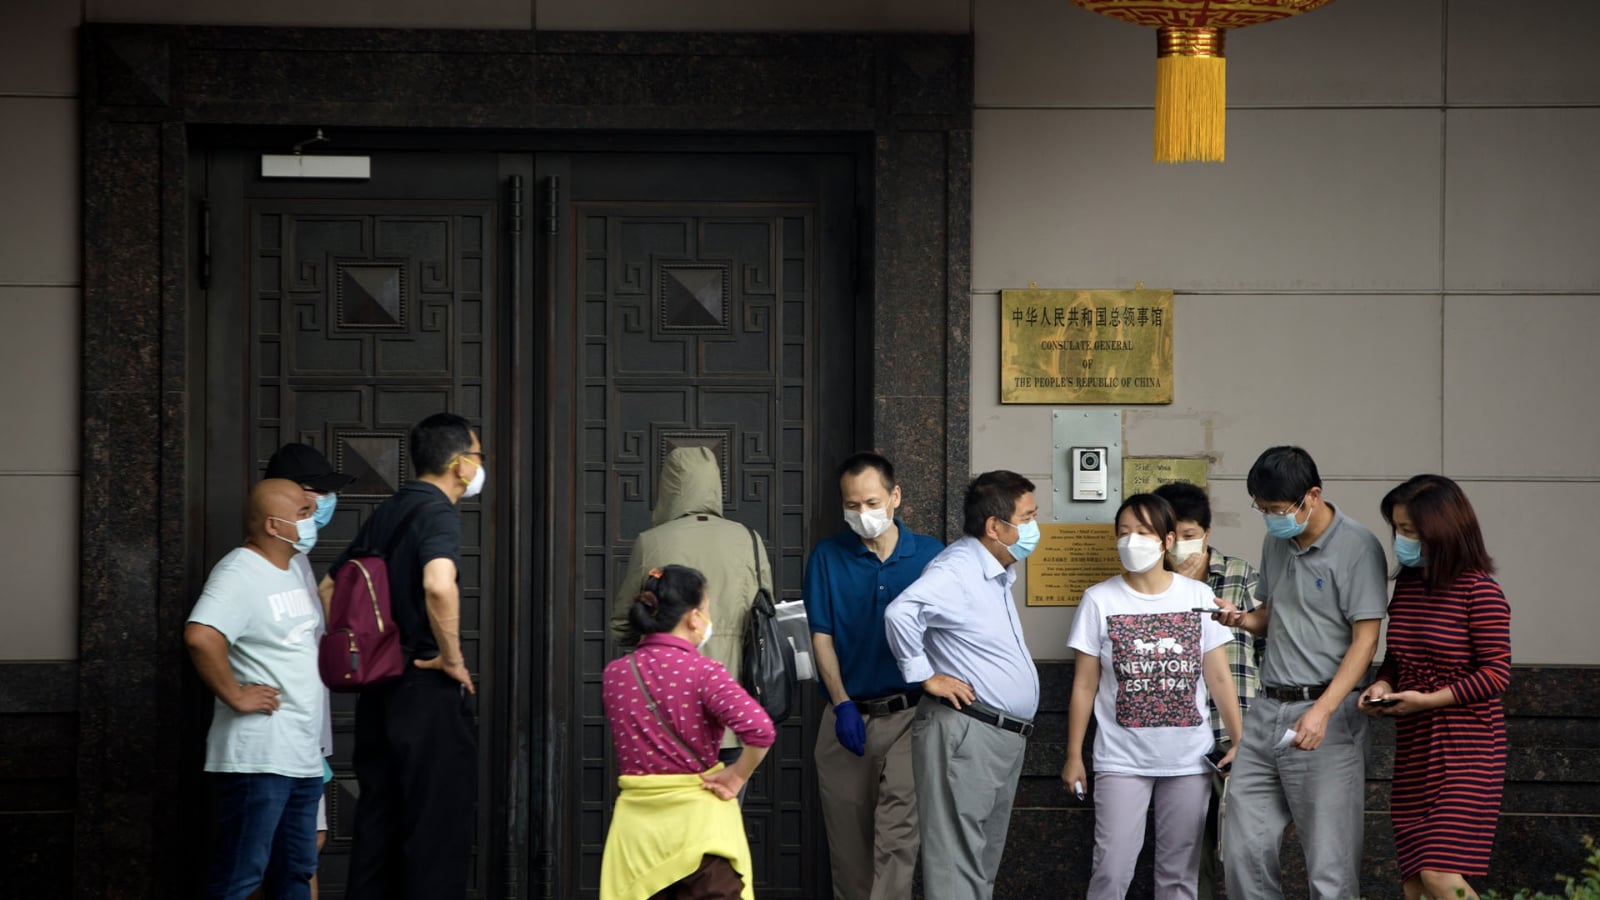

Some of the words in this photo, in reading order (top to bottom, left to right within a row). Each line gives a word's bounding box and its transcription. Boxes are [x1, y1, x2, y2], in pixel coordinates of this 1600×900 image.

[1012, 306, 1163, 327] 中华人民共和国总领事馆
[1041, 340, 1091, 351] CONSULATE
[1093, 340, 1134, 351] GENERAL
[1082, 359, 1094, 370] OF
[1014, 377, 1032, 388] THE
[1034, 377, 1074, 388] PEOPLE'S
[1076, 377, 1119, 388] REPUBLIC
[1121, 377, 1132, 388] OF
[1134, 377, 1161, 388] CHINA
[267, 588, 313, 621] PUM
[1120, 661, 1155, 675] NEW
[1158, 660, 1197, 673] YORK
[1125, 678, 1155, 692] EST.
